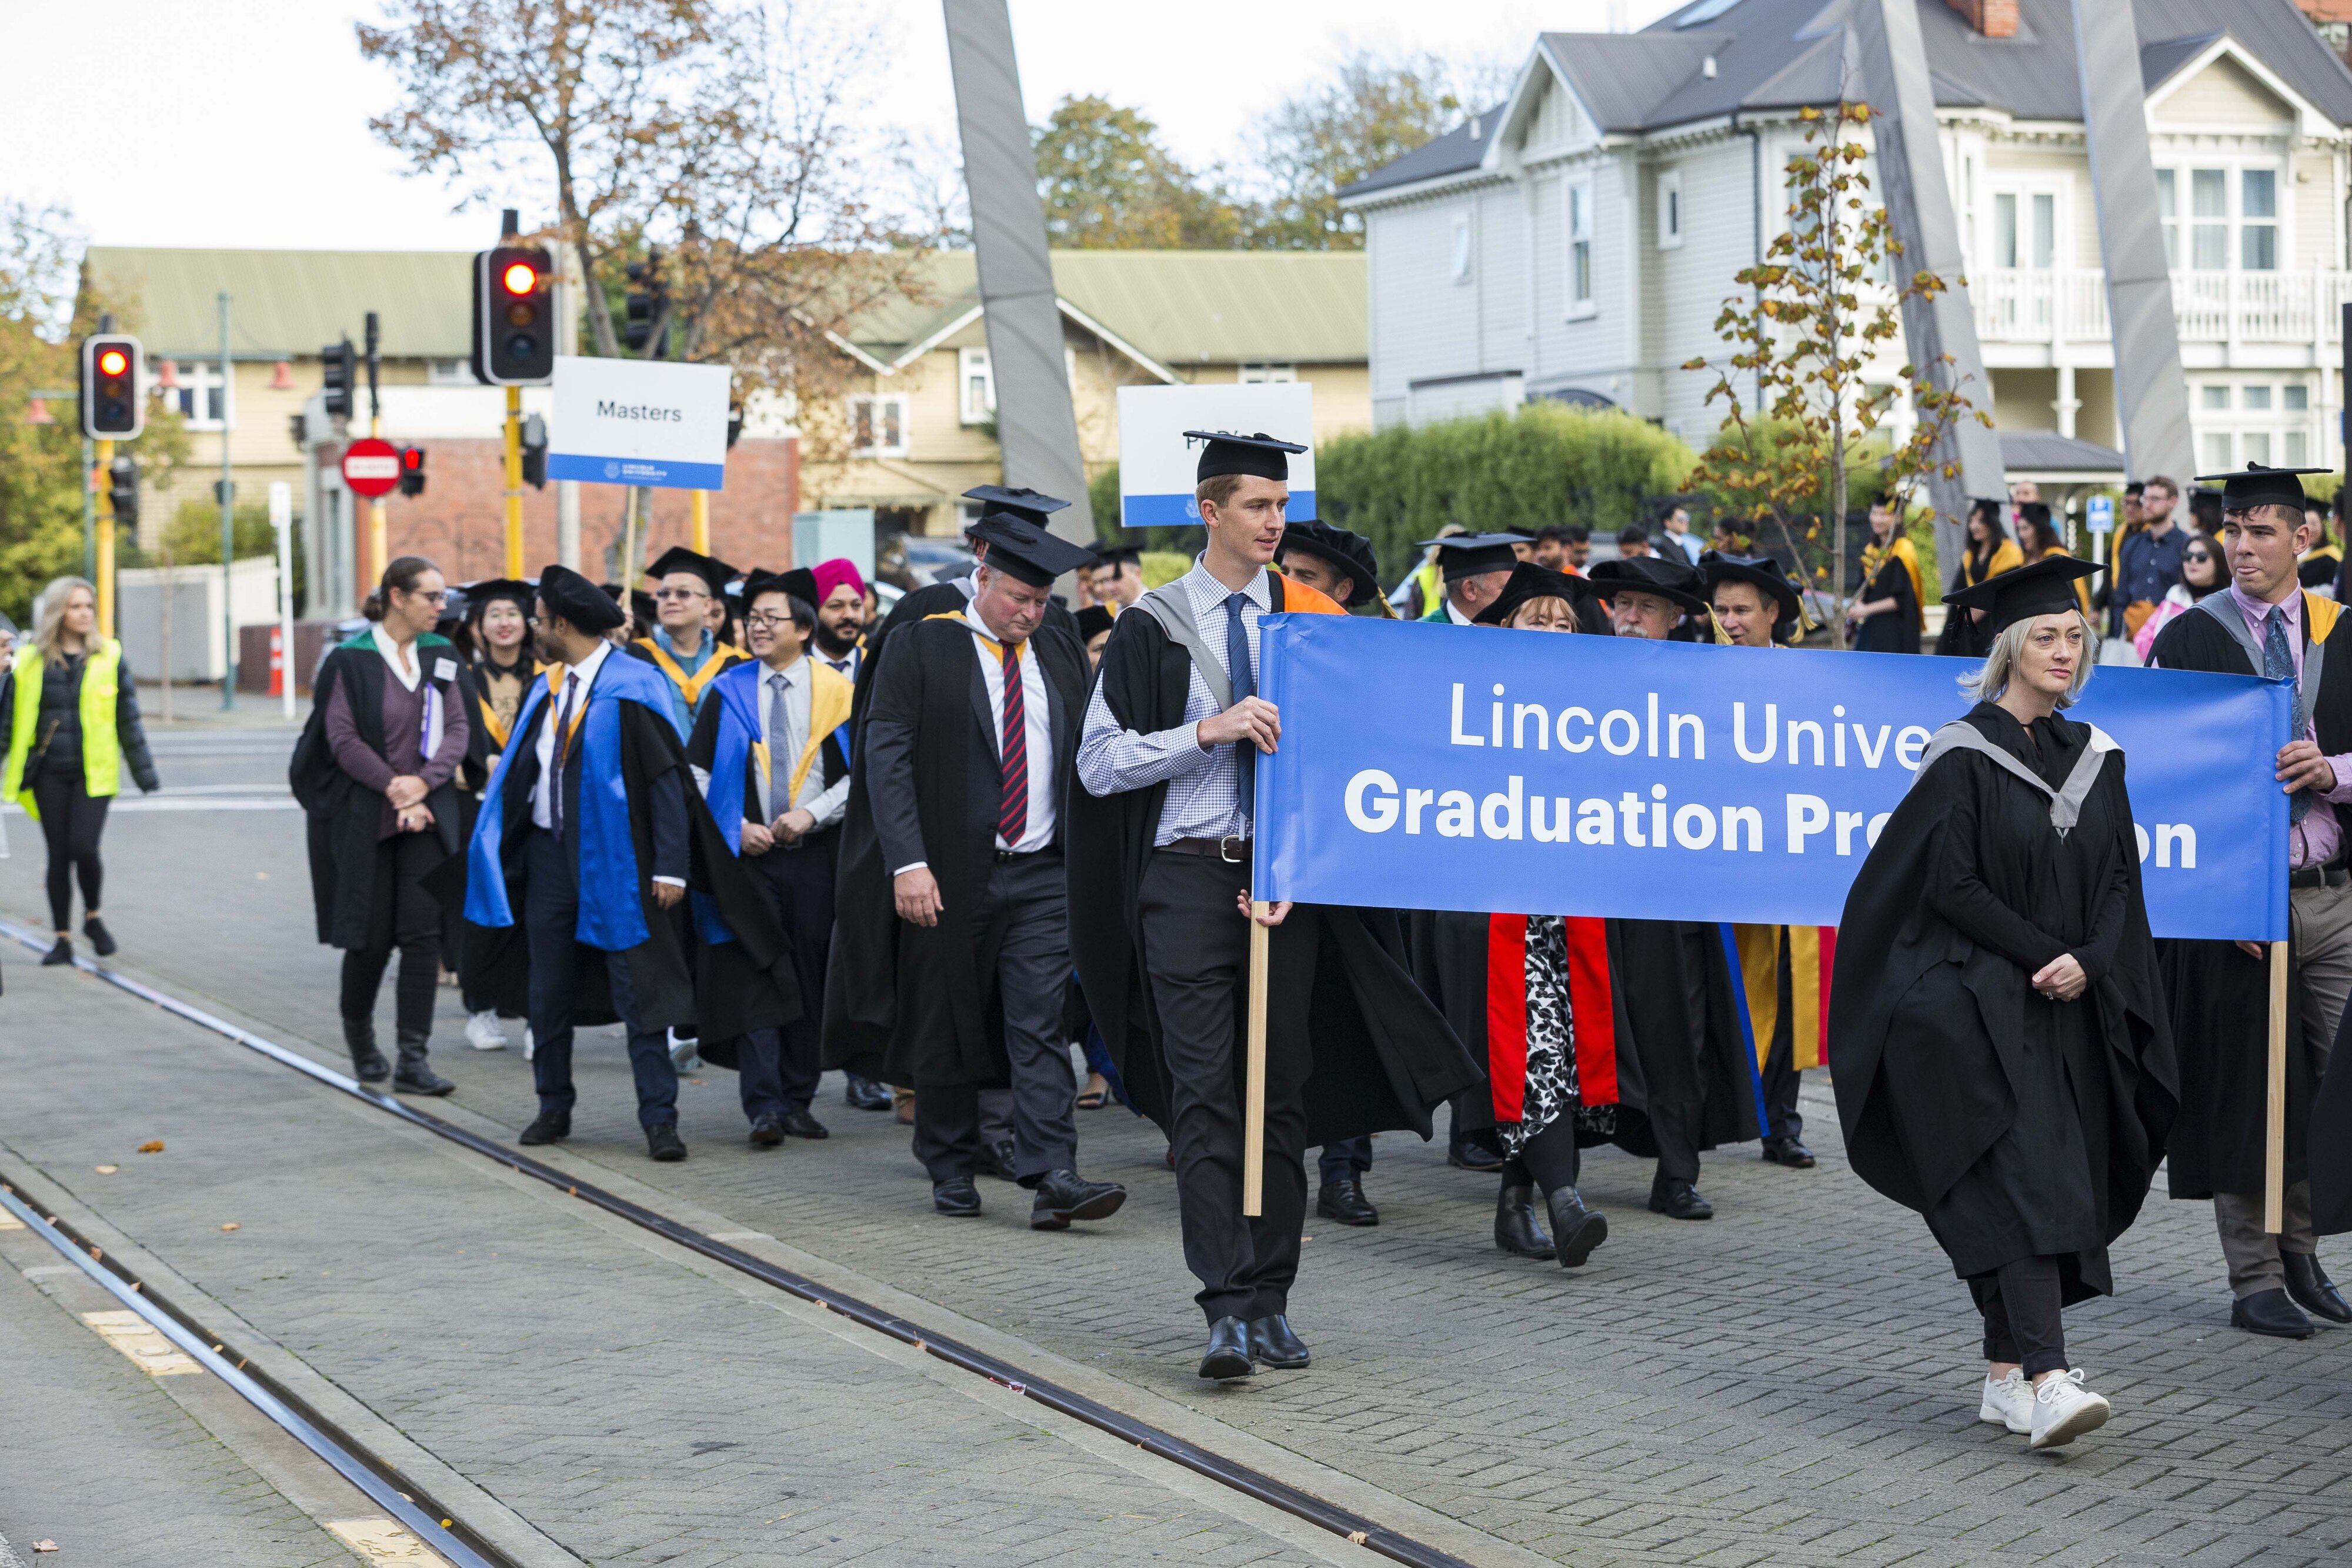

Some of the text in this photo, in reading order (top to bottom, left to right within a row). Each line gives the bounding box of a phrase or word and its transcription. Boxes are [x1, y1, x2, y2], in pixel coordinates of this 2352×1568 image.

[596, 399, 682, 423] Masters
[1450, 683, 1932, 771] Lincoln Unive
[1344, 769, 1763, 852] Graduation
